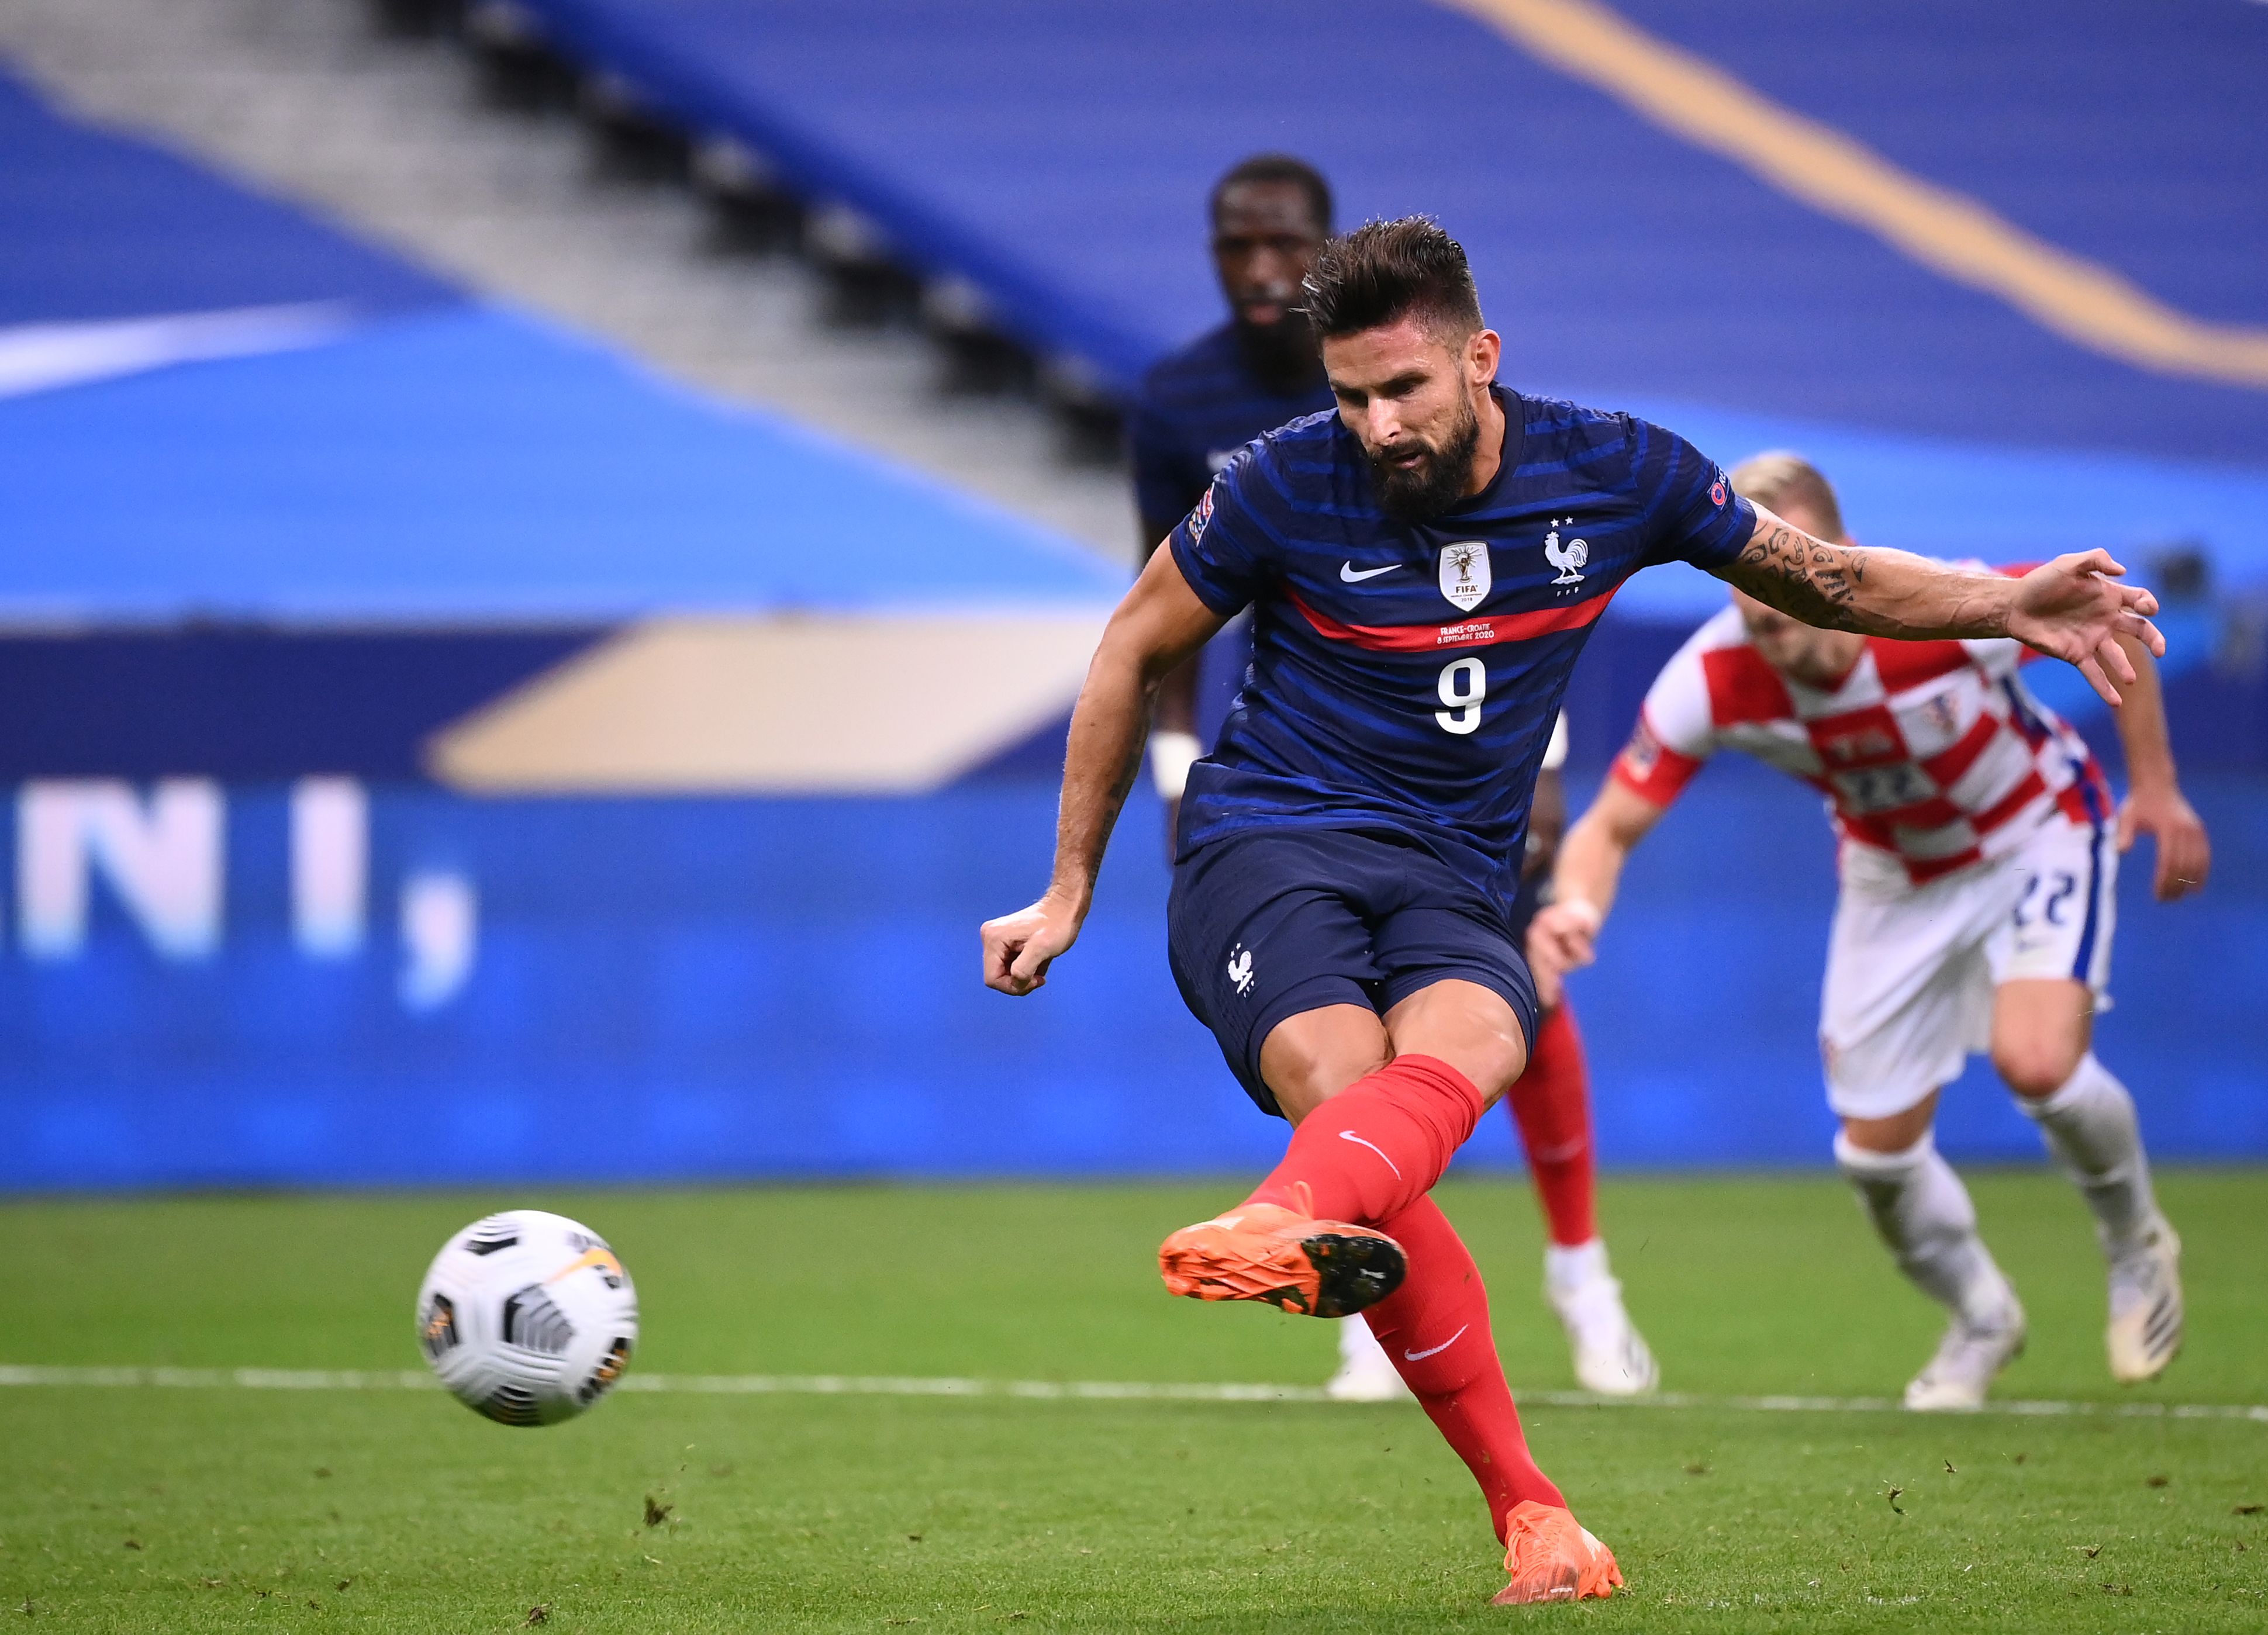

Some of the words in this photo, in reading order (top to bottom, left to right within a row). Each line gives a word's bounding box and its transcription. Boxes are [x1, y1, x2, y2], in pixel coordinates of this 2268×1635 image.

[1455, 585, 1478, 593] FIFA
[1437, 636, 1442, 644] 8
[1442, 632, 1473, 644] SEPTEMBRE
[1475, 630, 1494, 639] 2020
[1440, 623, 1490, 635] FRANCE-CROATIE
[1434, 656, 1486, 735] 9
[0, 776, 475, 1014] NI,
[2011, 870, 2076, 927] 22
